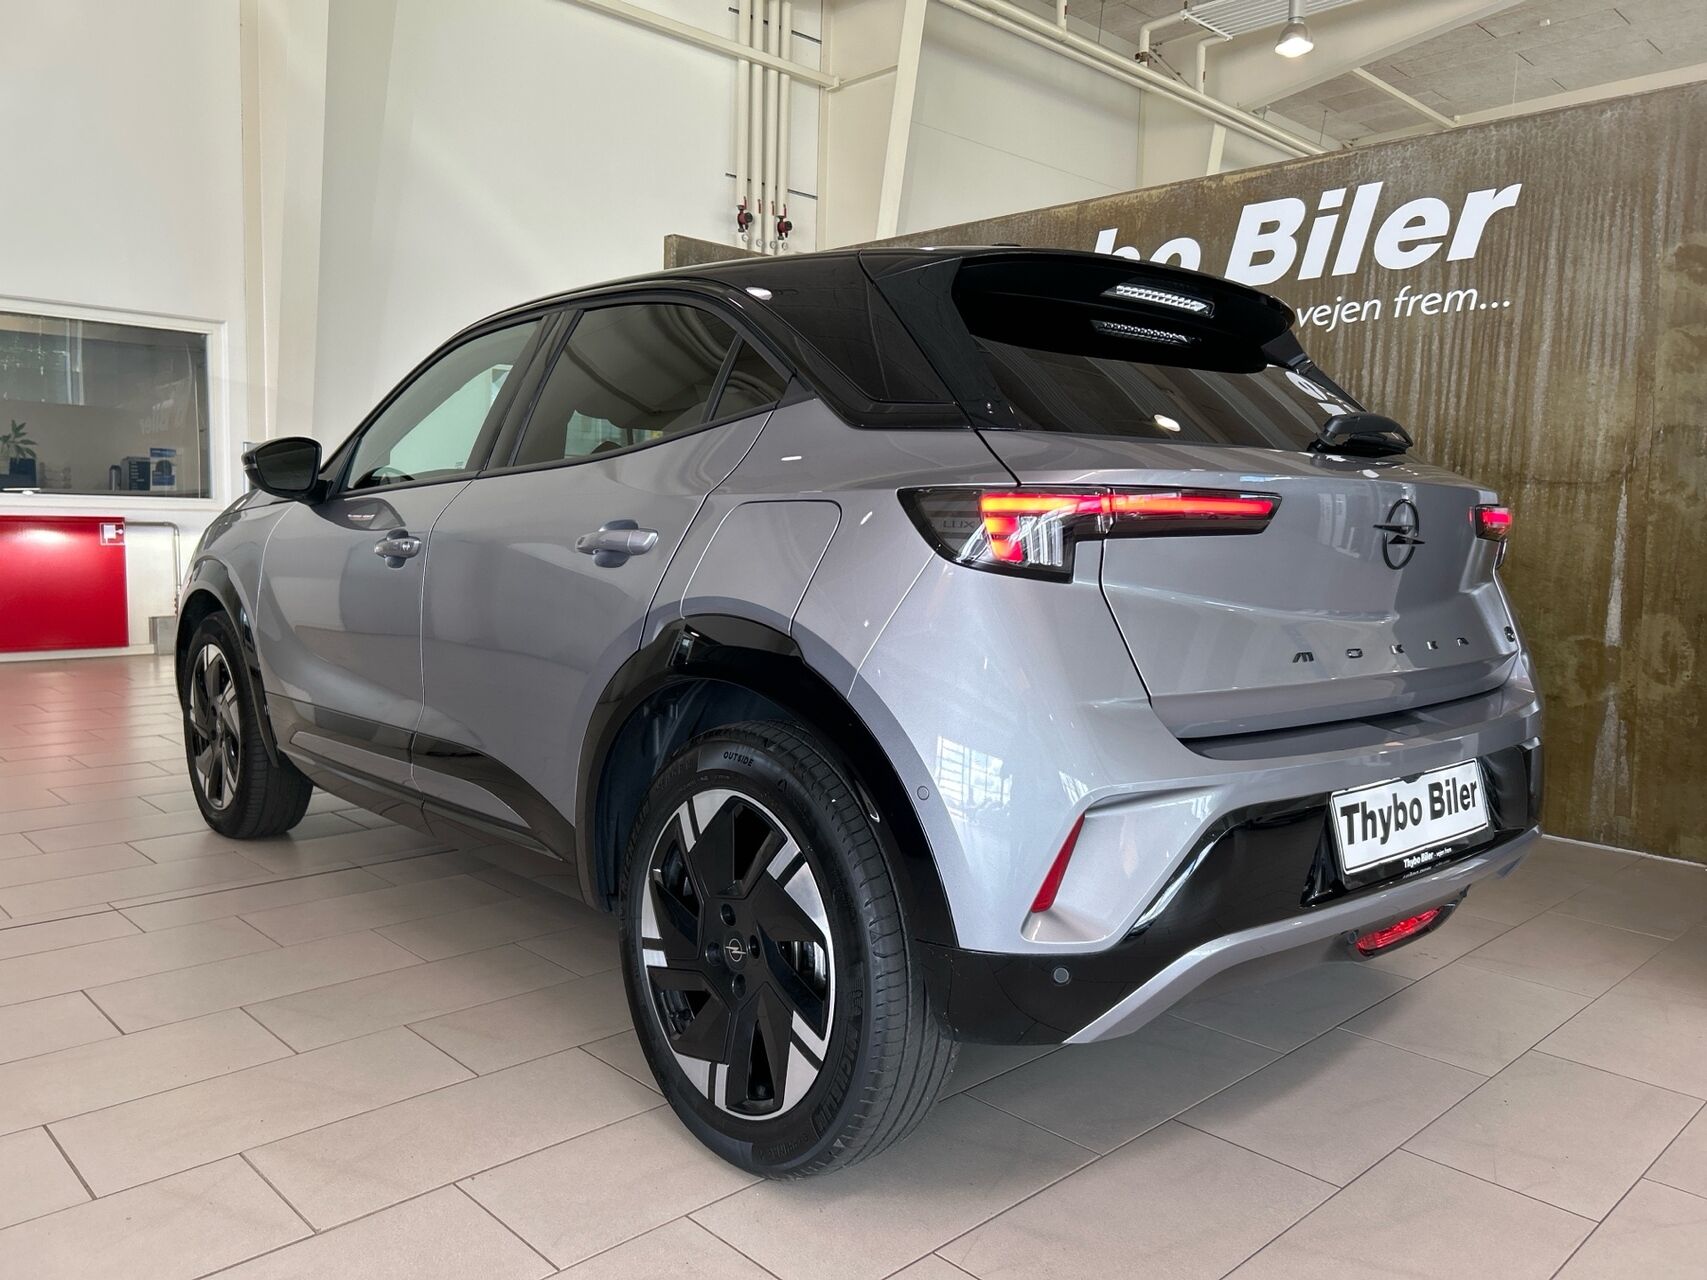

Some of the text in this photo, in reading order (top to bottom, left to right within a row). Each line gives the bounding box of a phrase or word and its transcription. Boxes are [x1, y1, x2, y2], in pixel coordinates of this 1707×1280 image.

[1224, 182, 1522, 286] Biler
[1296, 285, 1510, 332] vejen frem...
[1292, 637, 1469, 663] MOKKA
[724, 751, 754, 767] OUTSIDE
[1340, 777, 1477, 845] Thybo Biler
[1404, 856, 1420, 868] Thybo
[1421, 852, 1434, 863] Biler
